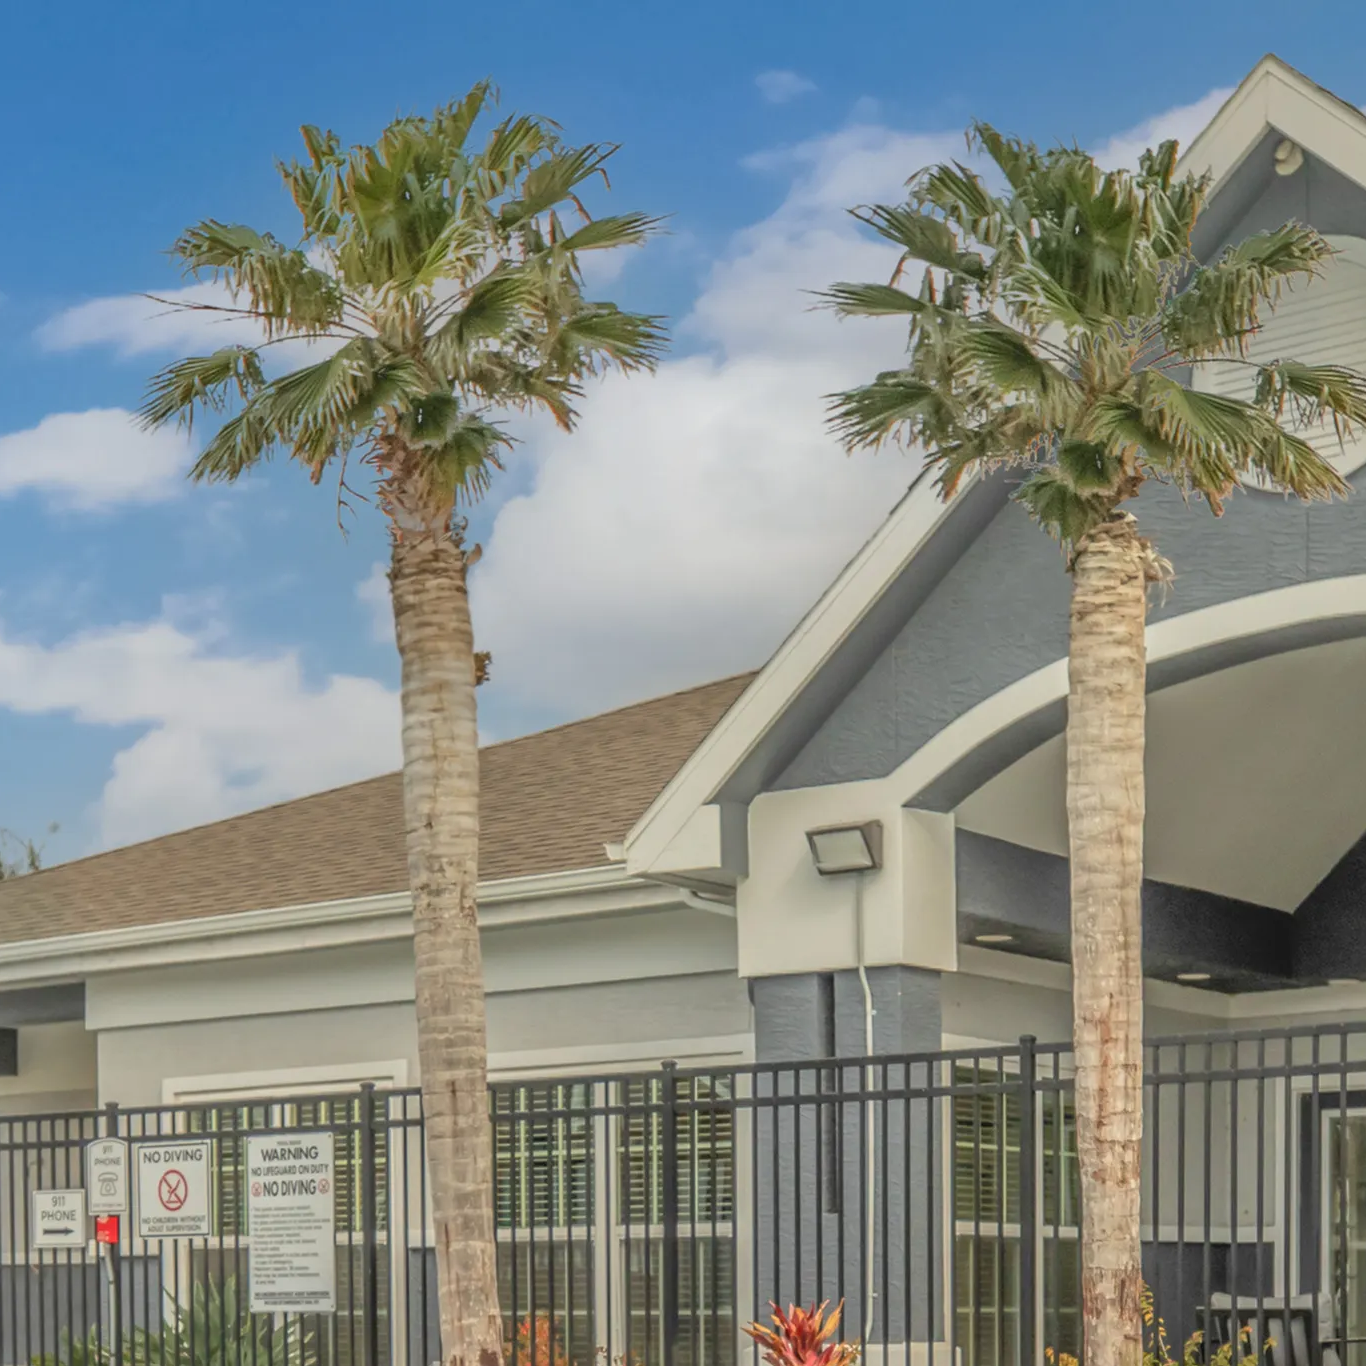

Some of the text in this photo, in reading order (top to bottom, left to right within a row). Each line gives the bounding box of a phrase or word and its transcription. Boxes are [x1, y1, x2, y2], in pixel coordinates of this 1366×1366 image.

[143, 1149, 203, 1163] NO DIVING
[261, 1146, 319, 1161] WARNING
[94, 1157, 121, 1166] PHONE
[251, 1163, 329, 1176] NO LIFEGUARD ON DUTY
[263, 1179, 317, 1197] NO DIVING
[51, 1196, 66, 1207] 911
[41, 1210, 77, 1221] PHONE
[152, 1215, 179, 1224] CHILDREN
[180, 1214, 206, 1223] WITHOUT
